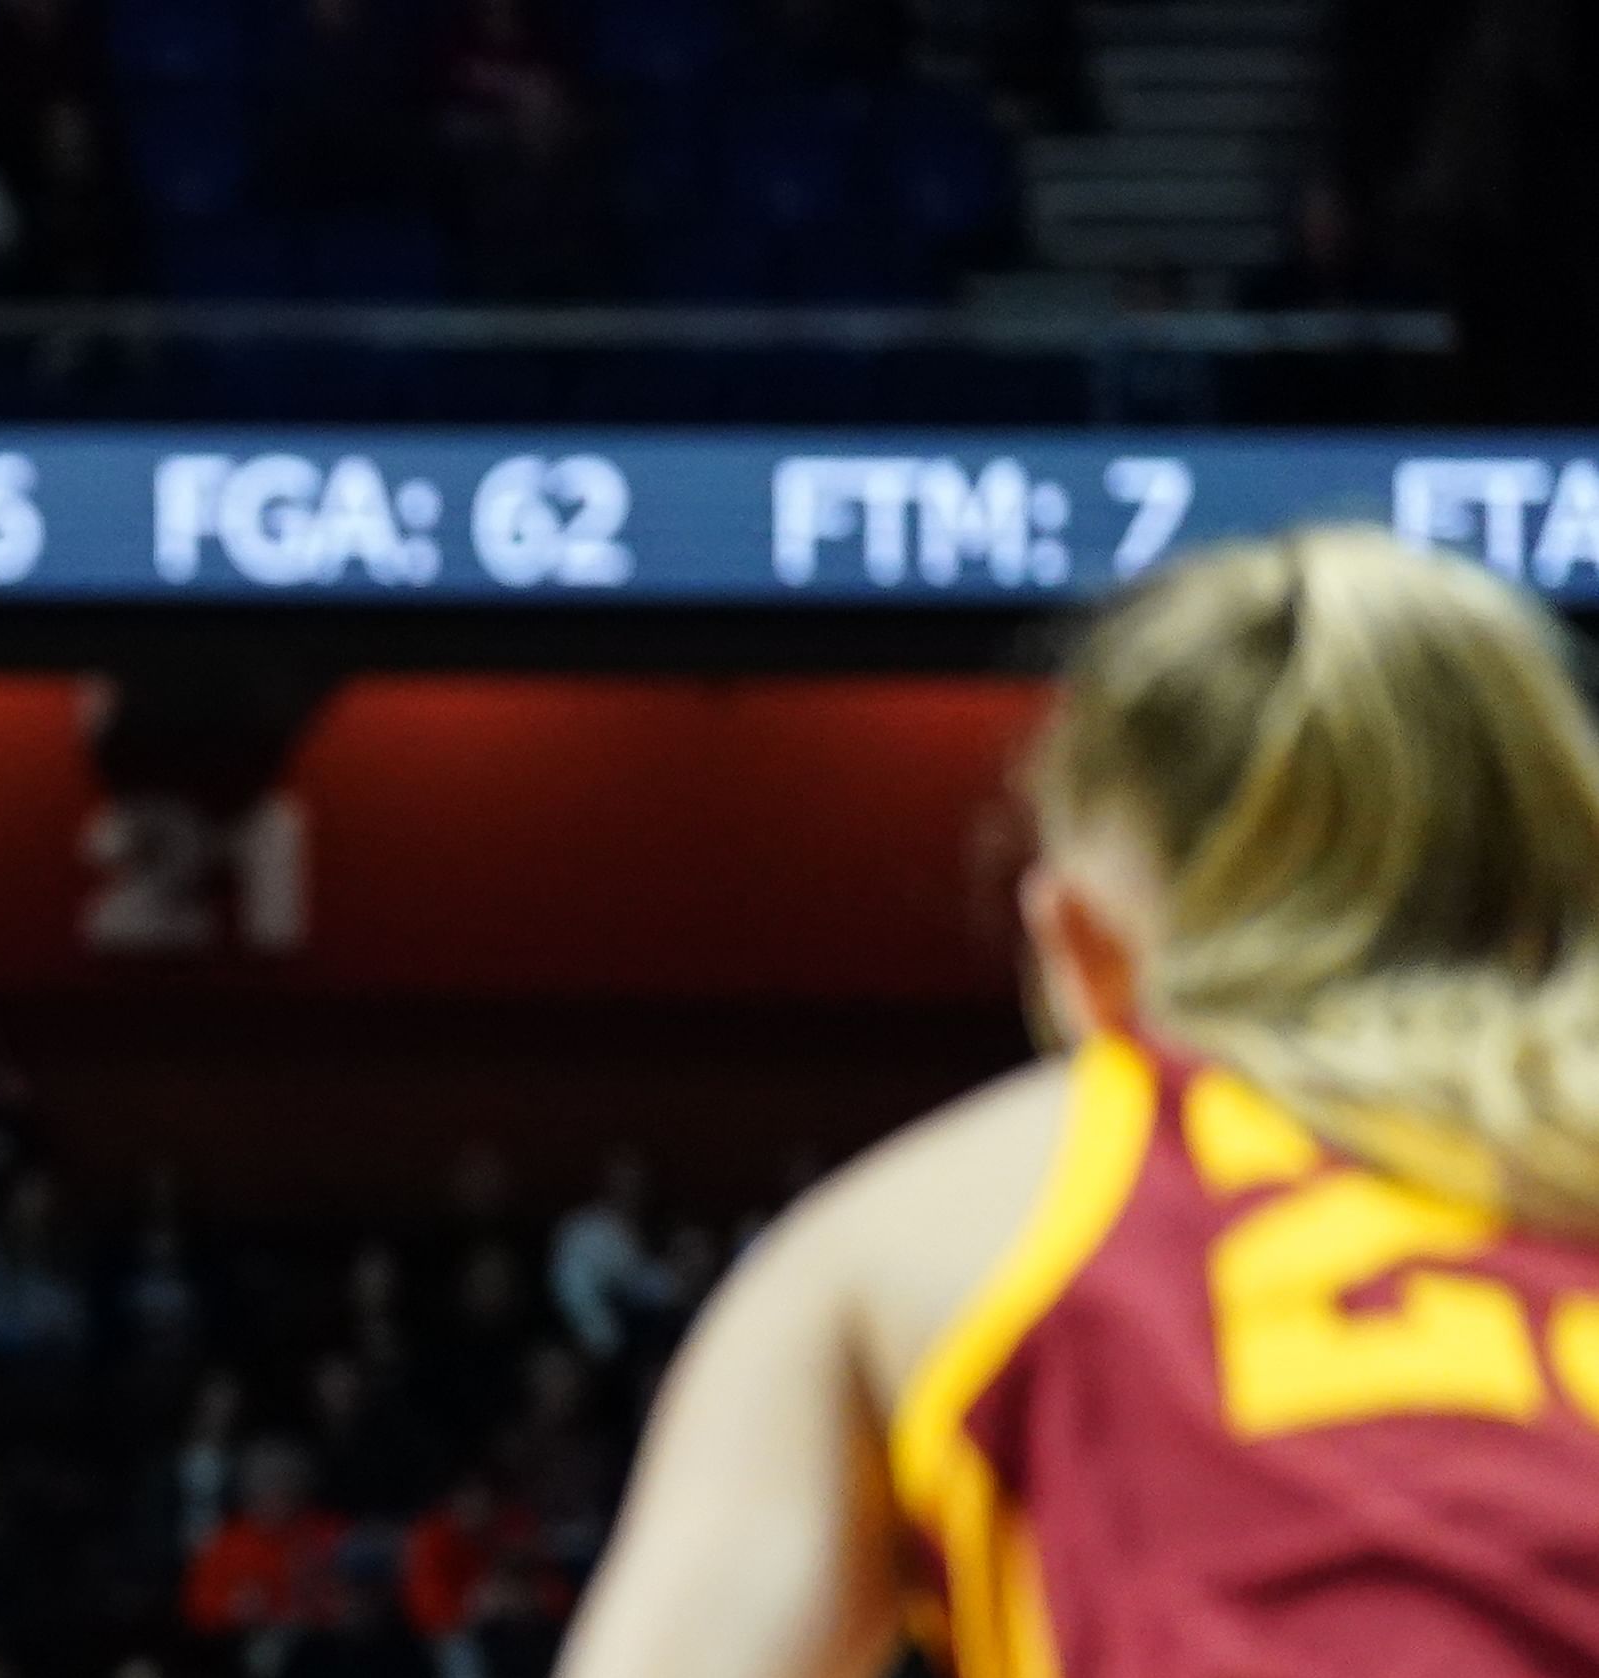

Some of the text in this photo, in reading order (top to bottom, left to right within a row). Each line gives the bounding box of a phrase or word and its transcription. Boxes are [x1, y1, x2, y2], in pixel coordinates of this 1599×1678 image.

[153, 454, 443, 587] FGA:
[471, 455, 636, 588] 62
[771, 455, 1072, 588] FTM:
[1105, 456, 1195, 580] 7
[75, 795, 311, 952] 21
[1183, 1070, 1599, 1447] 2
